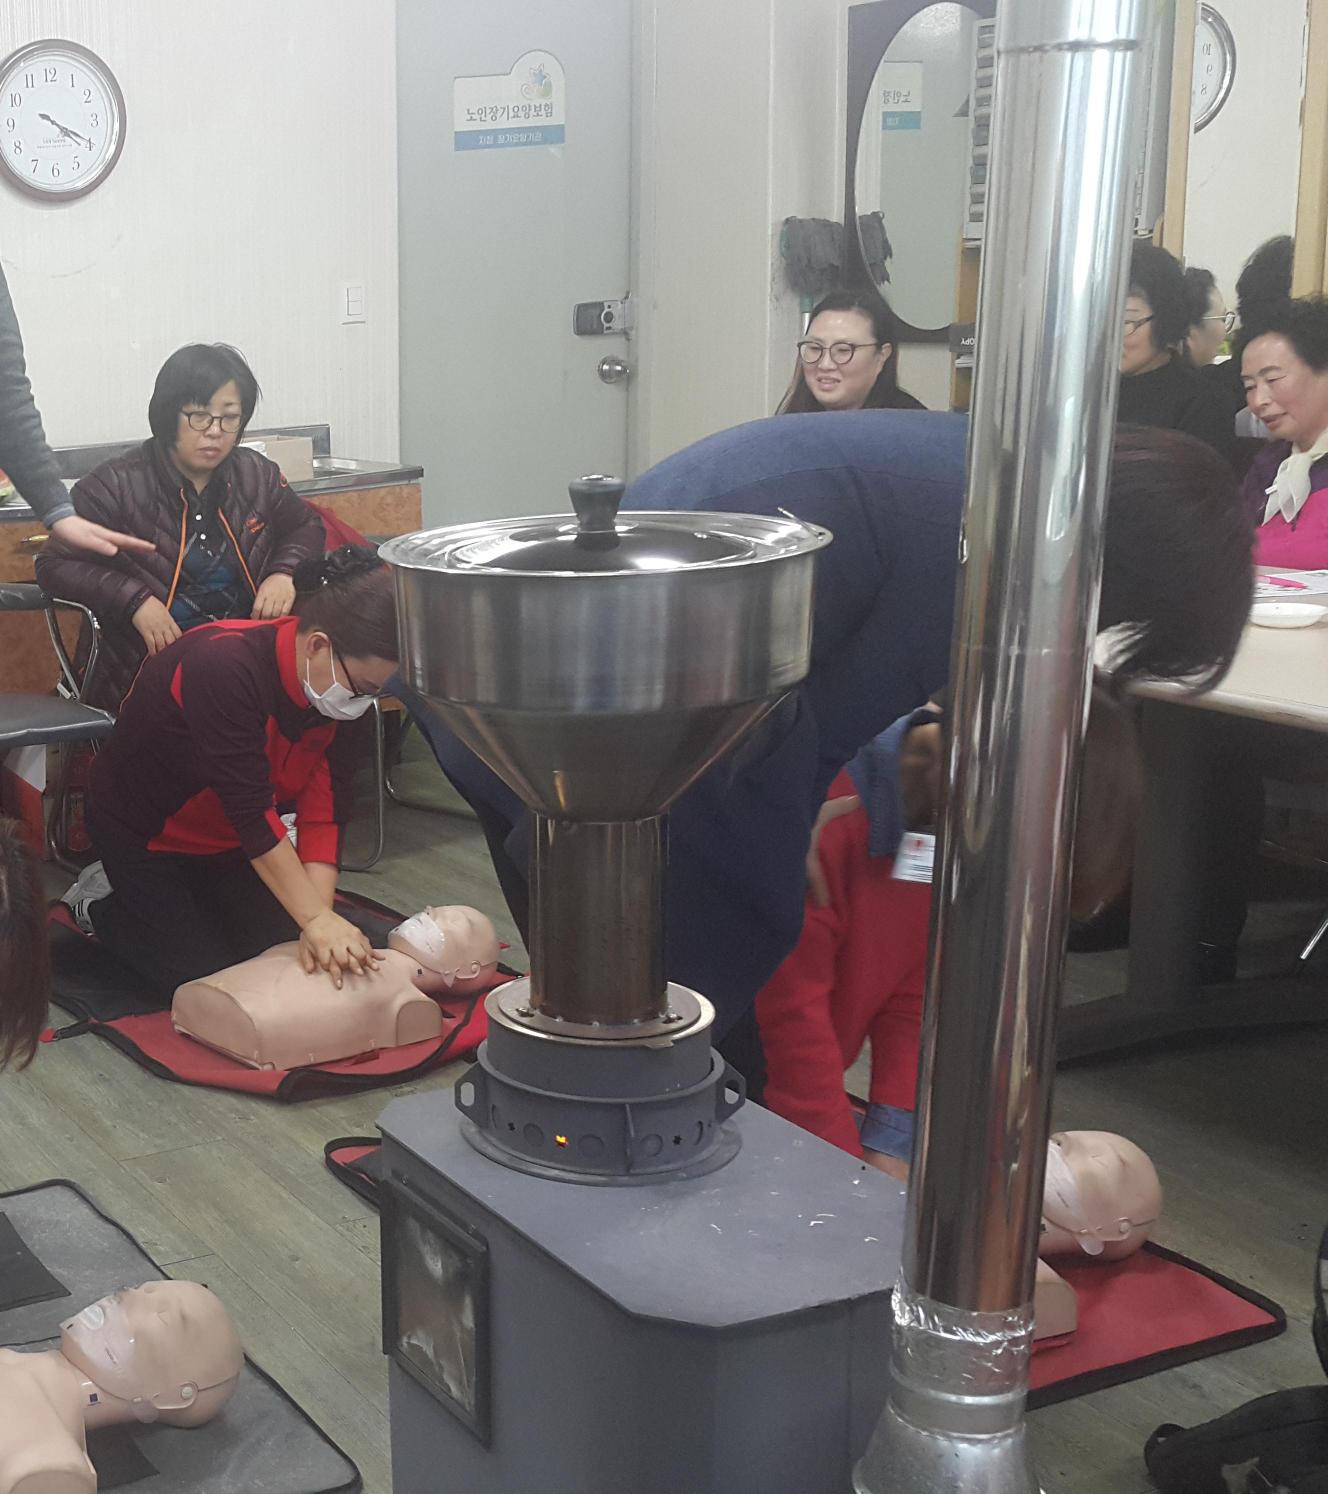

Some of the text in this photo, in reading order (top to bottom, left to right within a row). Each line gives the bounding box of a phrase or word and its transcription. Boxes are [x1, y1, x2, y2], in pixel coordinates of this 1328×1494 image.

[24, 73, 35, 88] 11
[43, 67, 57, 83] 12
[70, 73, 75, 88] 1
[9, 92, 22, 108] 10
[83, 88, 92, 104] 2
[90, 112, 99, 128] 3
[465, 102, 553, 122] 노인장기요양보험
[6, 117, 15, 133] 9
[13, 140, 23, 155] 8
[85, 137, 96, 151] 4
[31, 158, 39, 173] 7
[51, 162, 60, 177] 6
[72, 155, 80, 171] 5
